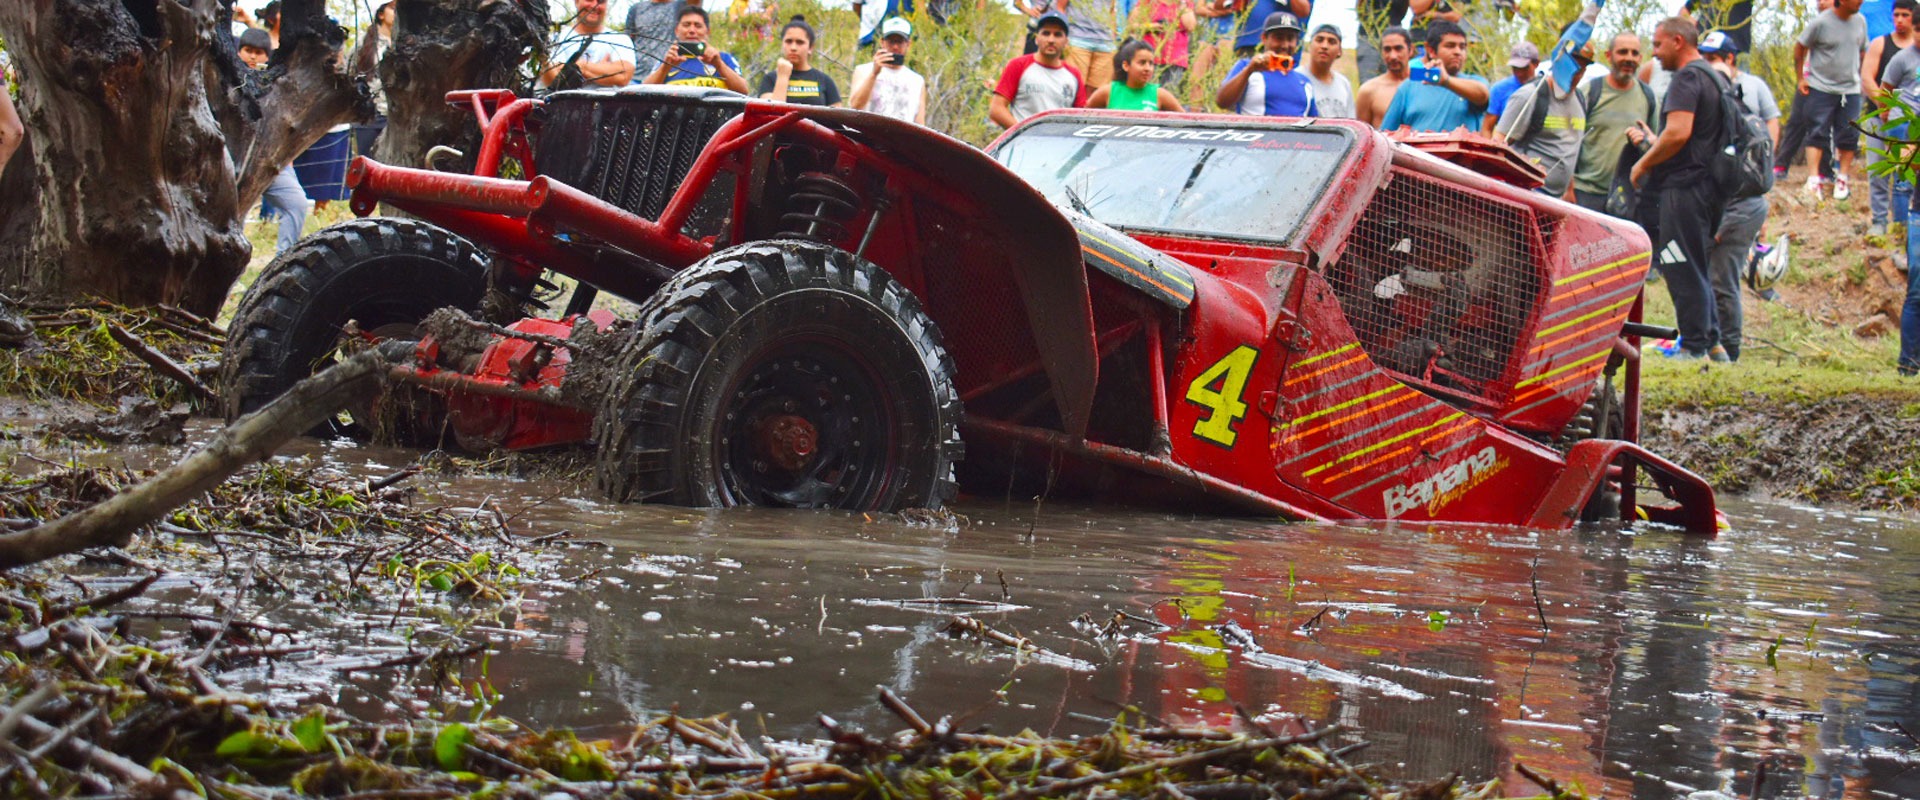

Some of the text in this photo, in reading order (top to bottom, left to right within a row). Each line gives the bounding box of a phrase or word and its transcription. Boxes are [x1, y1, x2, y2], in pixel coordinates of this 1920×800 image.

[1073, 124, 1265, 142] El Moncho
[1185, 343, 1261, 451] 4
[1382, 446, 1497, 519] Banana
